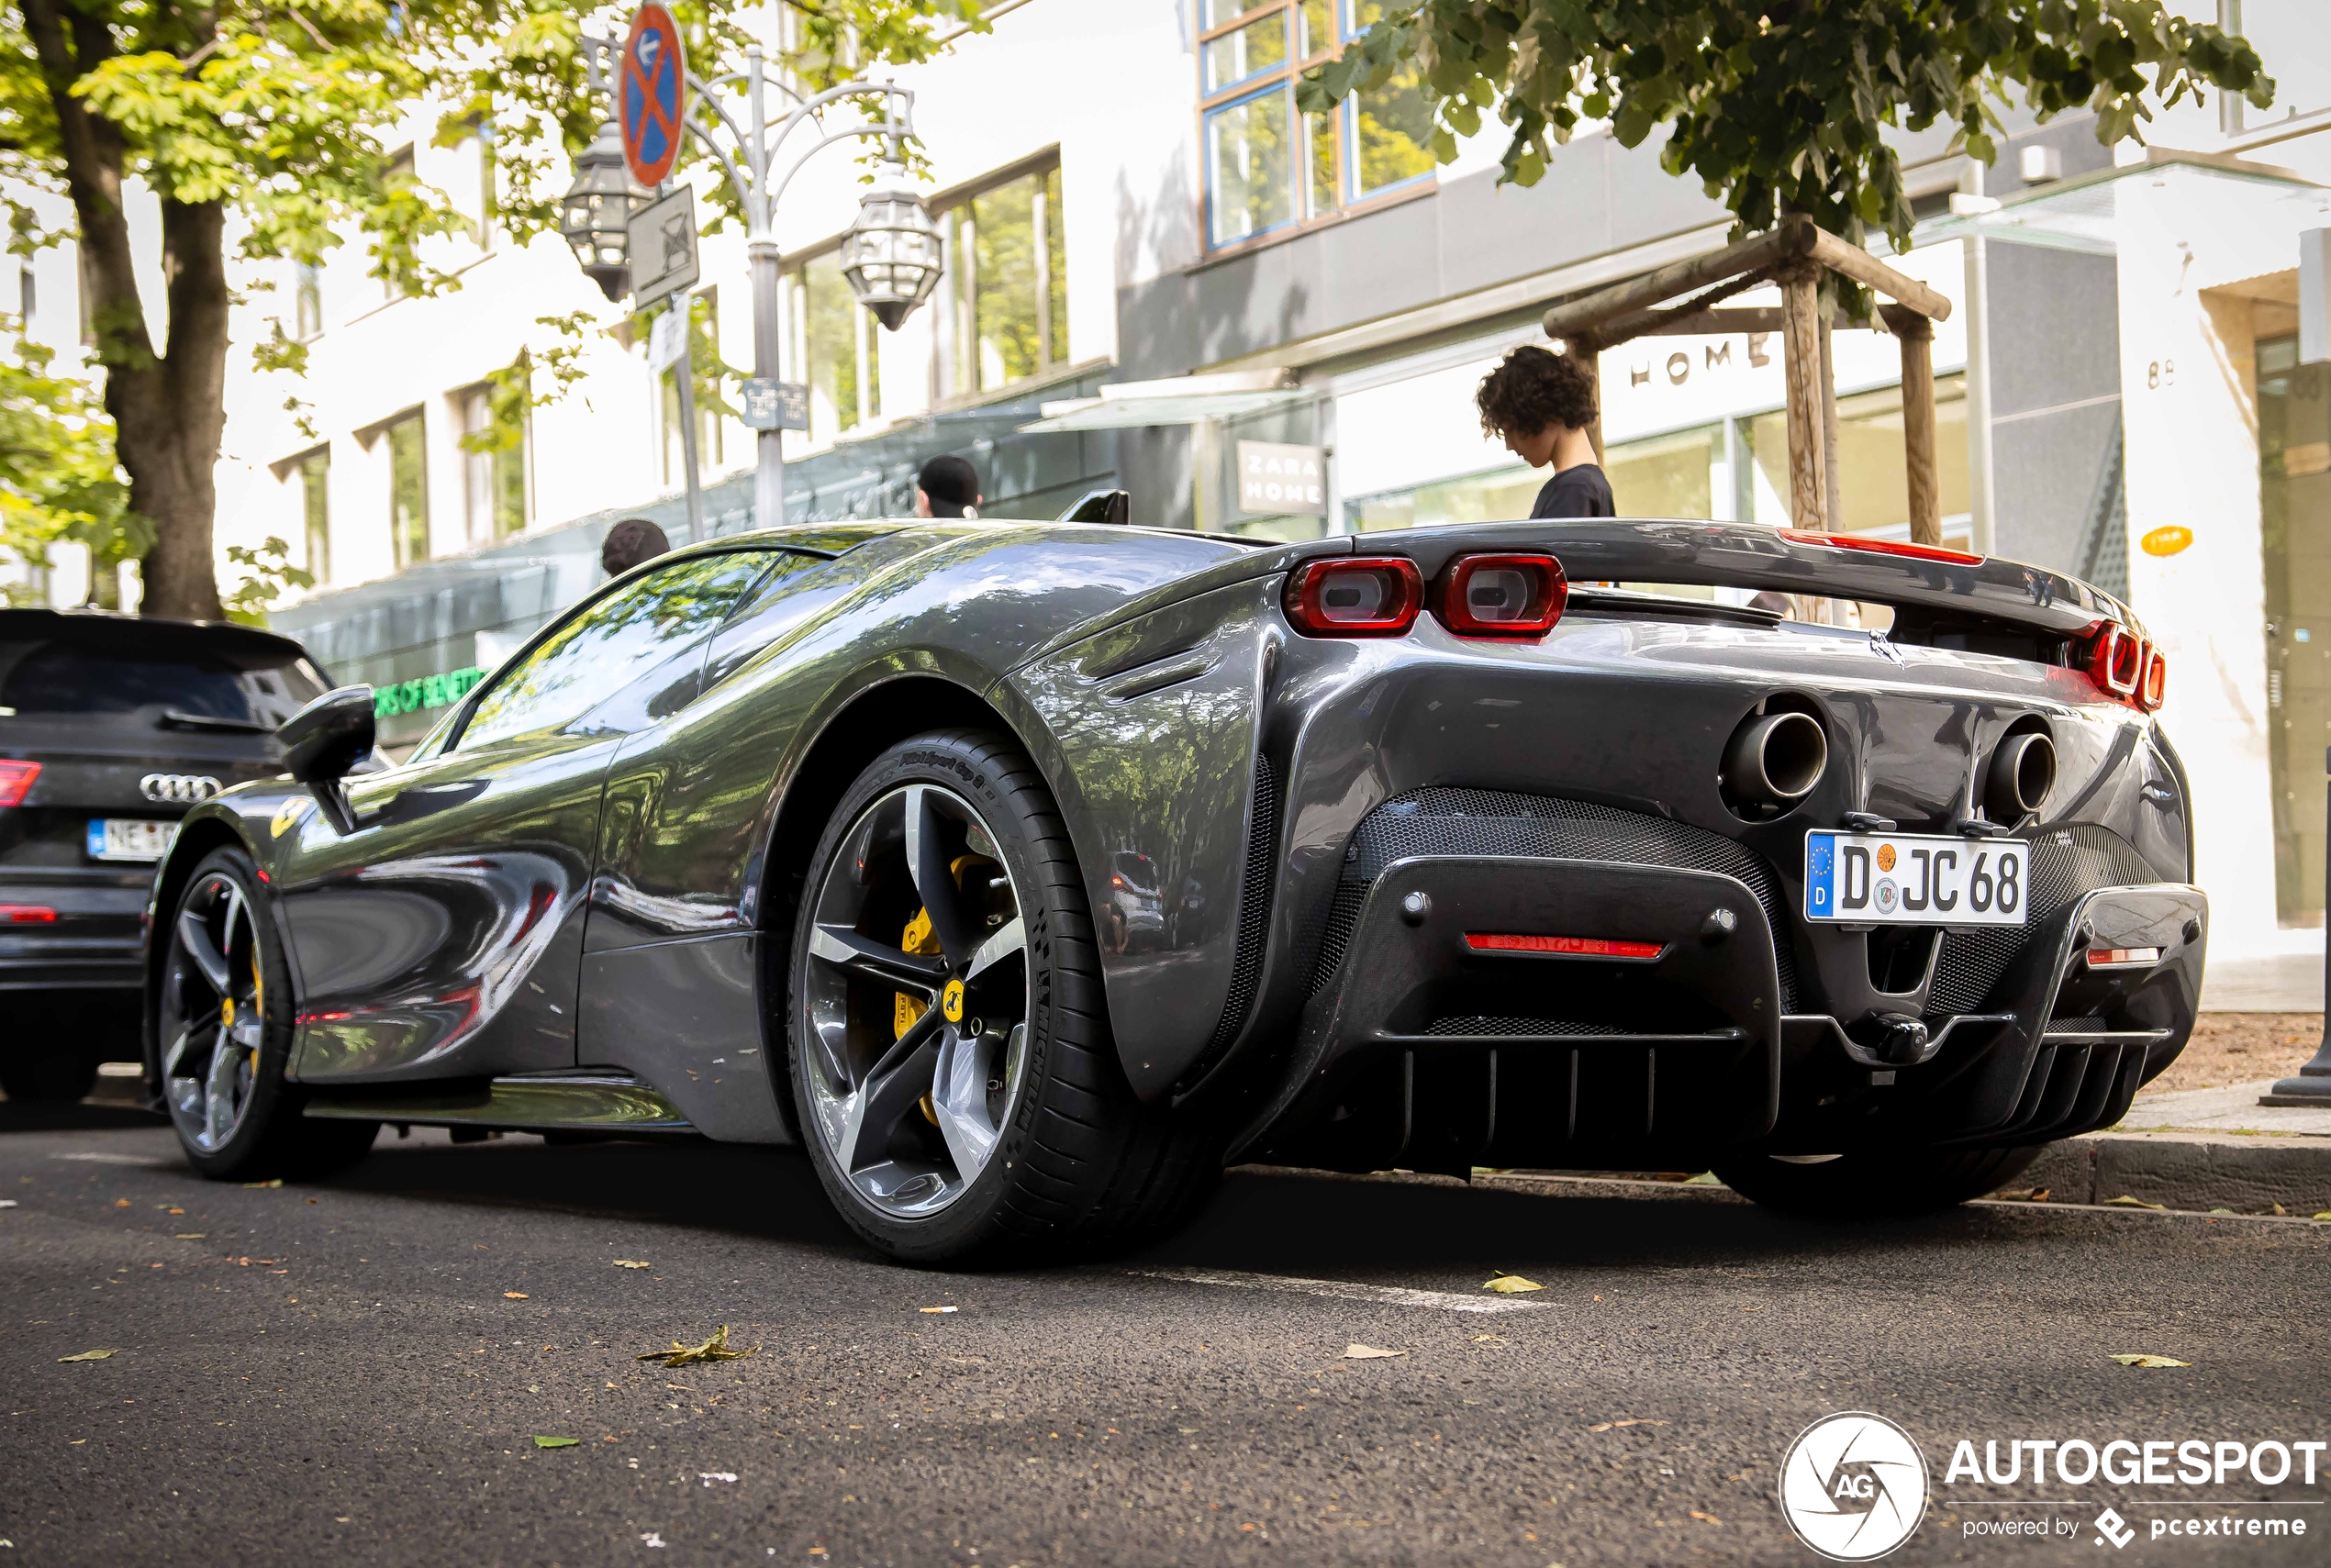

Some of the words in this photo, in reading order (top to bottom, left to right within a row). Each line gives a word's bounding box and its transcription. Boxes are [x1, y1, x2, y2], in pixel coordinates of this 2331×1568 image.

[1631, 332, 1770, 389] HOME
[1248, 455, 1319, 477] ZARA
[1246, 482, 1322, 505] HOME
[924, 751, 956, 770] Sport
[954, 761, 975, 782] Cup
[972, 774, 985, 789] 2
[1814, 886, 1825, 906] D
[1841, 845, 1870, 909] D
[1902, 849, 1958, 912] JC
[1969, 851, 2019, 914] 68
[1019, 1003, 1050, 1131] MICHELIN
